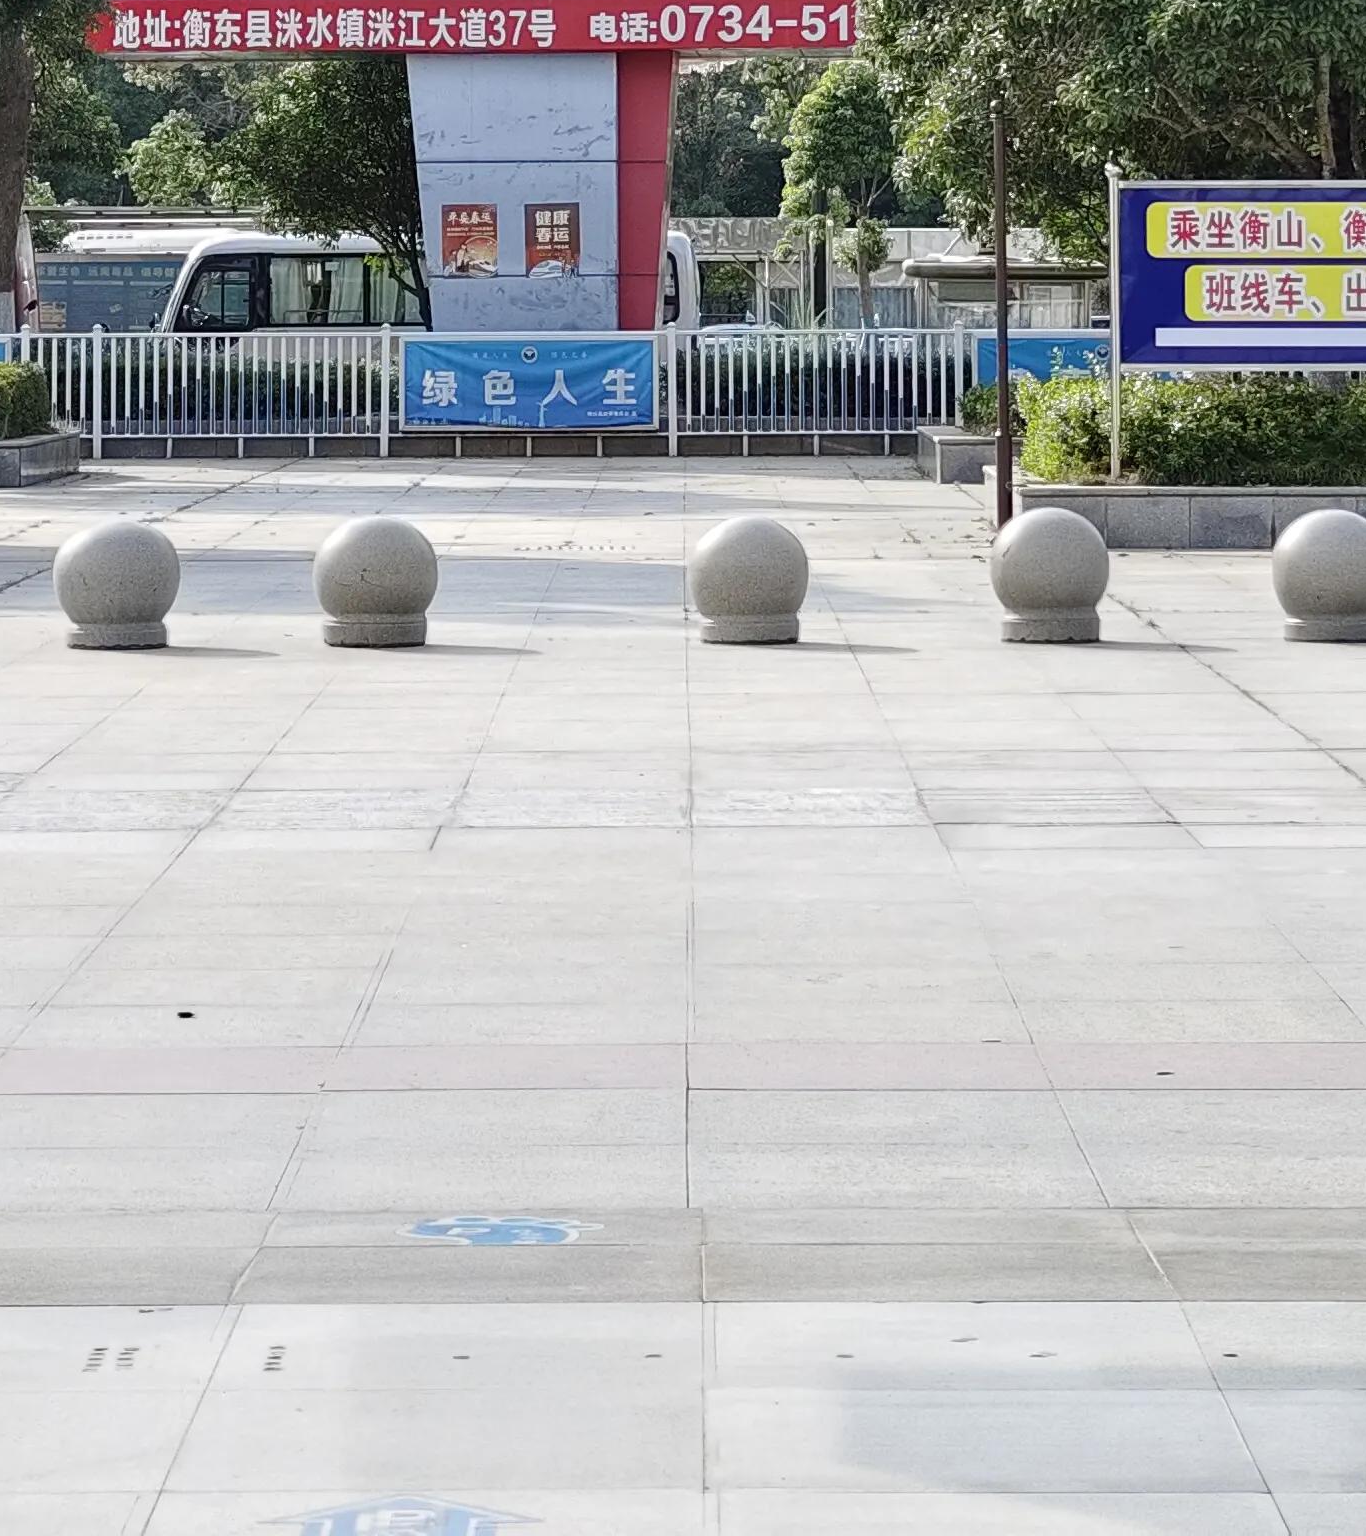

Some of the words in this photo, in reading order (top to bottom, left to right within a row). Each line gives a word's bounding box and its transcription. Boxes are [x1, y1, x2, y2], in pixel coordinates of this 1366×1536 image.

[535, 210, 570, 226] 健康
[535, 227, 569, 243] 春运
[421, 368, 637, 407] 绿色人生
